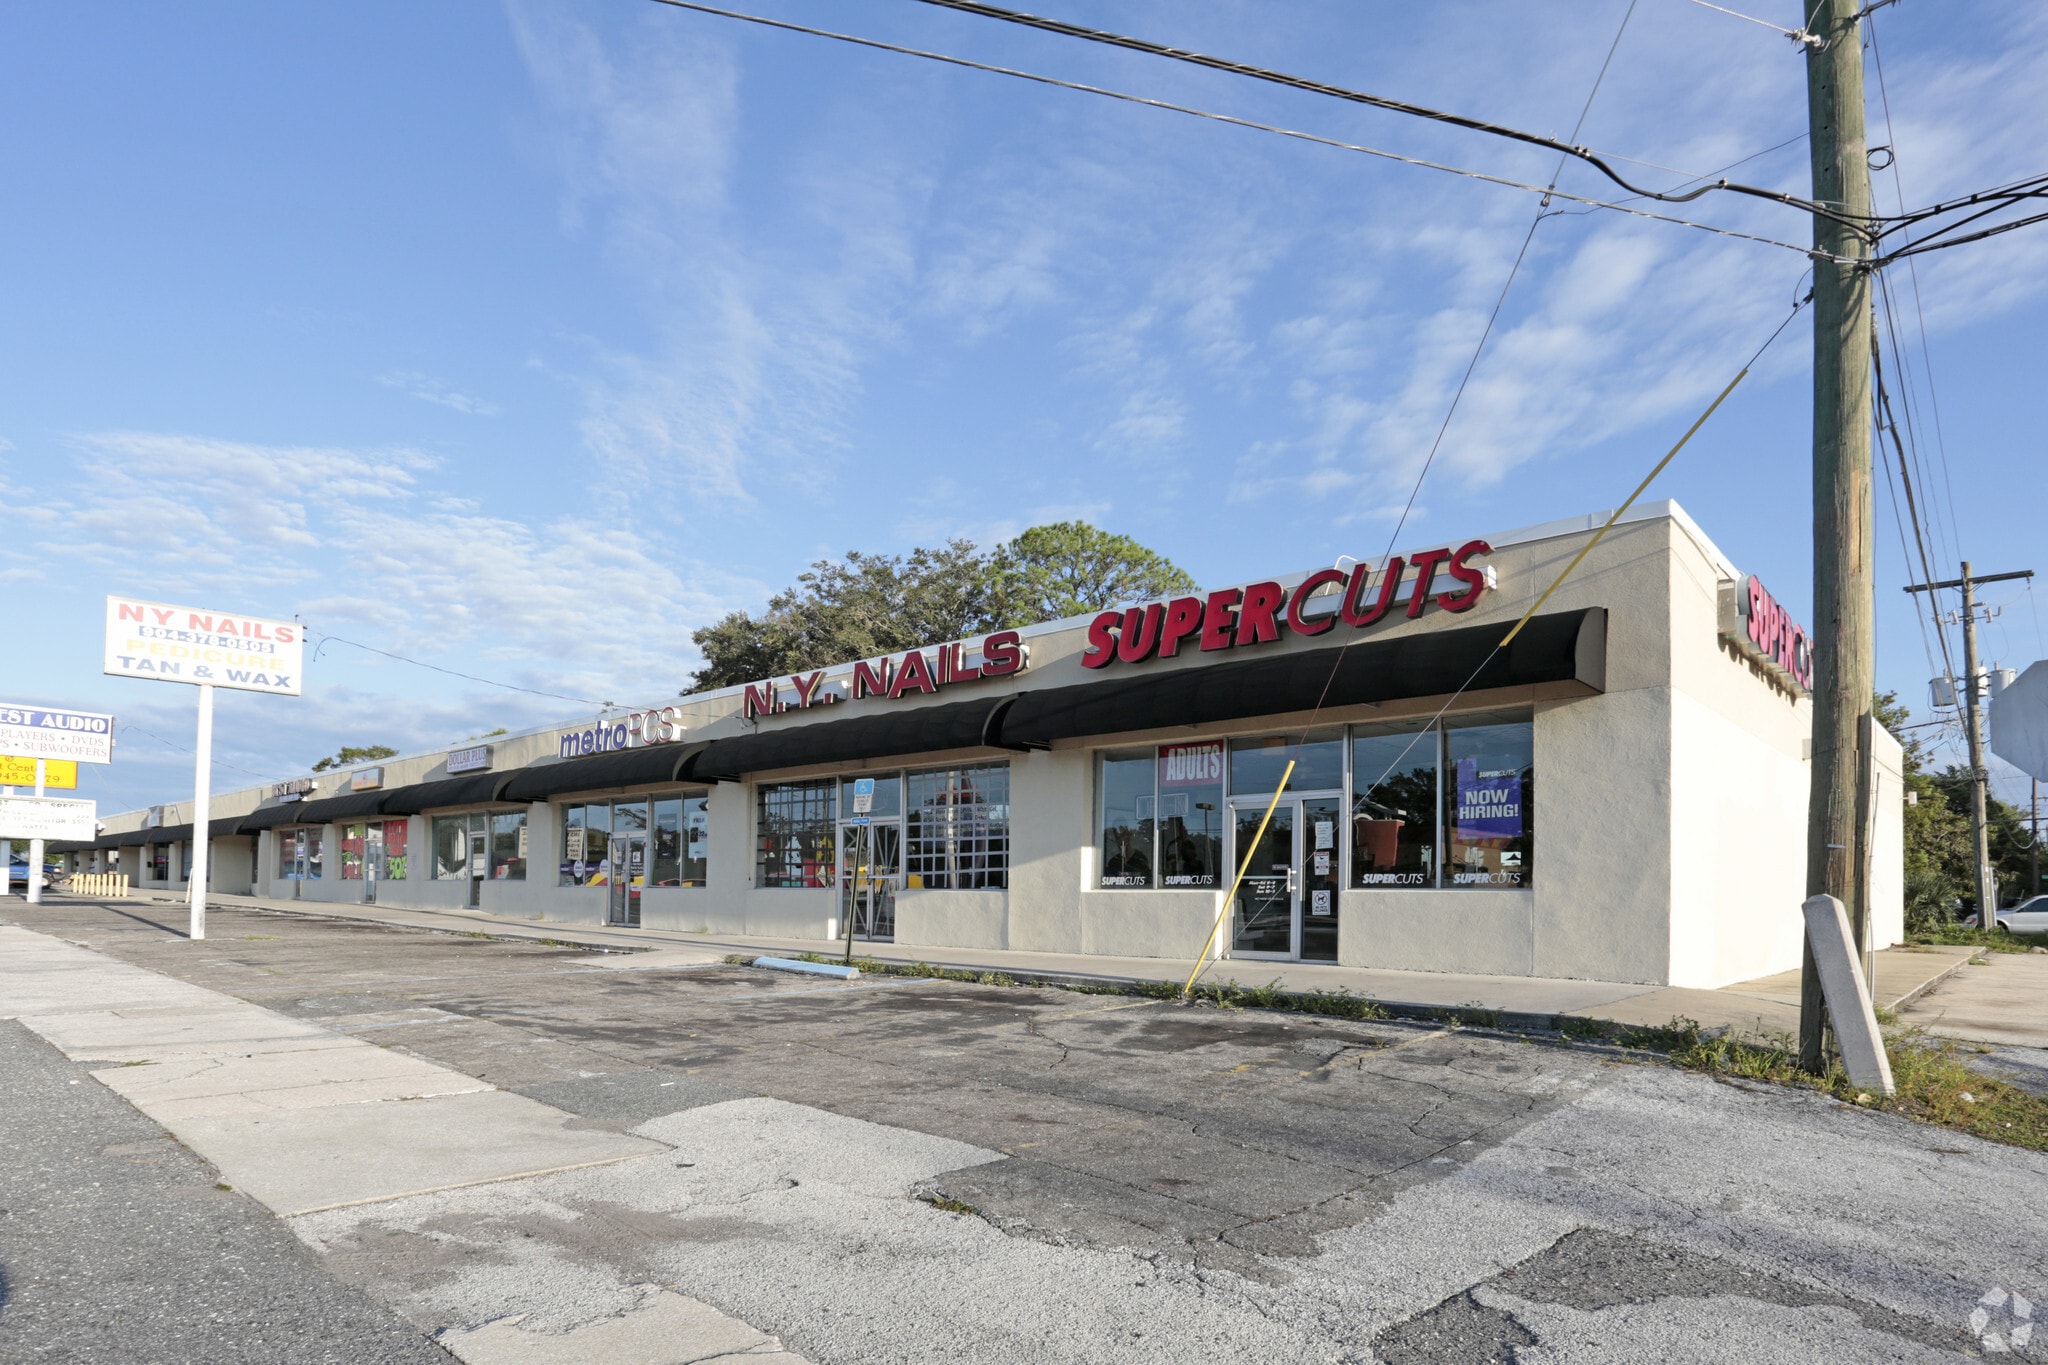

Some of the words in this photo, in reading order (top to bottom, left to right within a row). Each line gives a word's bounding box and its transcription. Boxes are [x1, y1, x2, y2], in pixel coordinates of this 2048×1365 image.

[1081, 539, 1496, 669] SUPERCUTS
[118, 603, 175, 626] NY
[188, 613, 295, 643] NAILS
[125, 638, 285, 672] PEDICURE
[116, 655, 181, 675] TAN
[192, 664, 214, 679] &
[226, 668, 292, 689] WAX
[743, 671, 836, 718] N.Y.
[852, 631, 1025, 699] NAILS
[41, 714, 106, 733] AUDIO
[1, 728, 56, 742] PLAYERS
[71, 735, 105, 747] DVDS
[23, 741, 108, 757] SUBWOOFERS
[1166, 743, 1220, 781] ADULTS
[1478, 768, 1516, 779] SUPERCUTS
[1465, 788, 1509, 806] NOW
[1459, 803, 1519, 820] HIRING!
[1101, 876, 1146, 886] SUPERCUTS
[1164, 874, 1214, 885] SUPERCUTS
[1362, 873, 1424, 885] SUPERCUTS
[1453, 872, 1522, 884] SUPERCUTS
